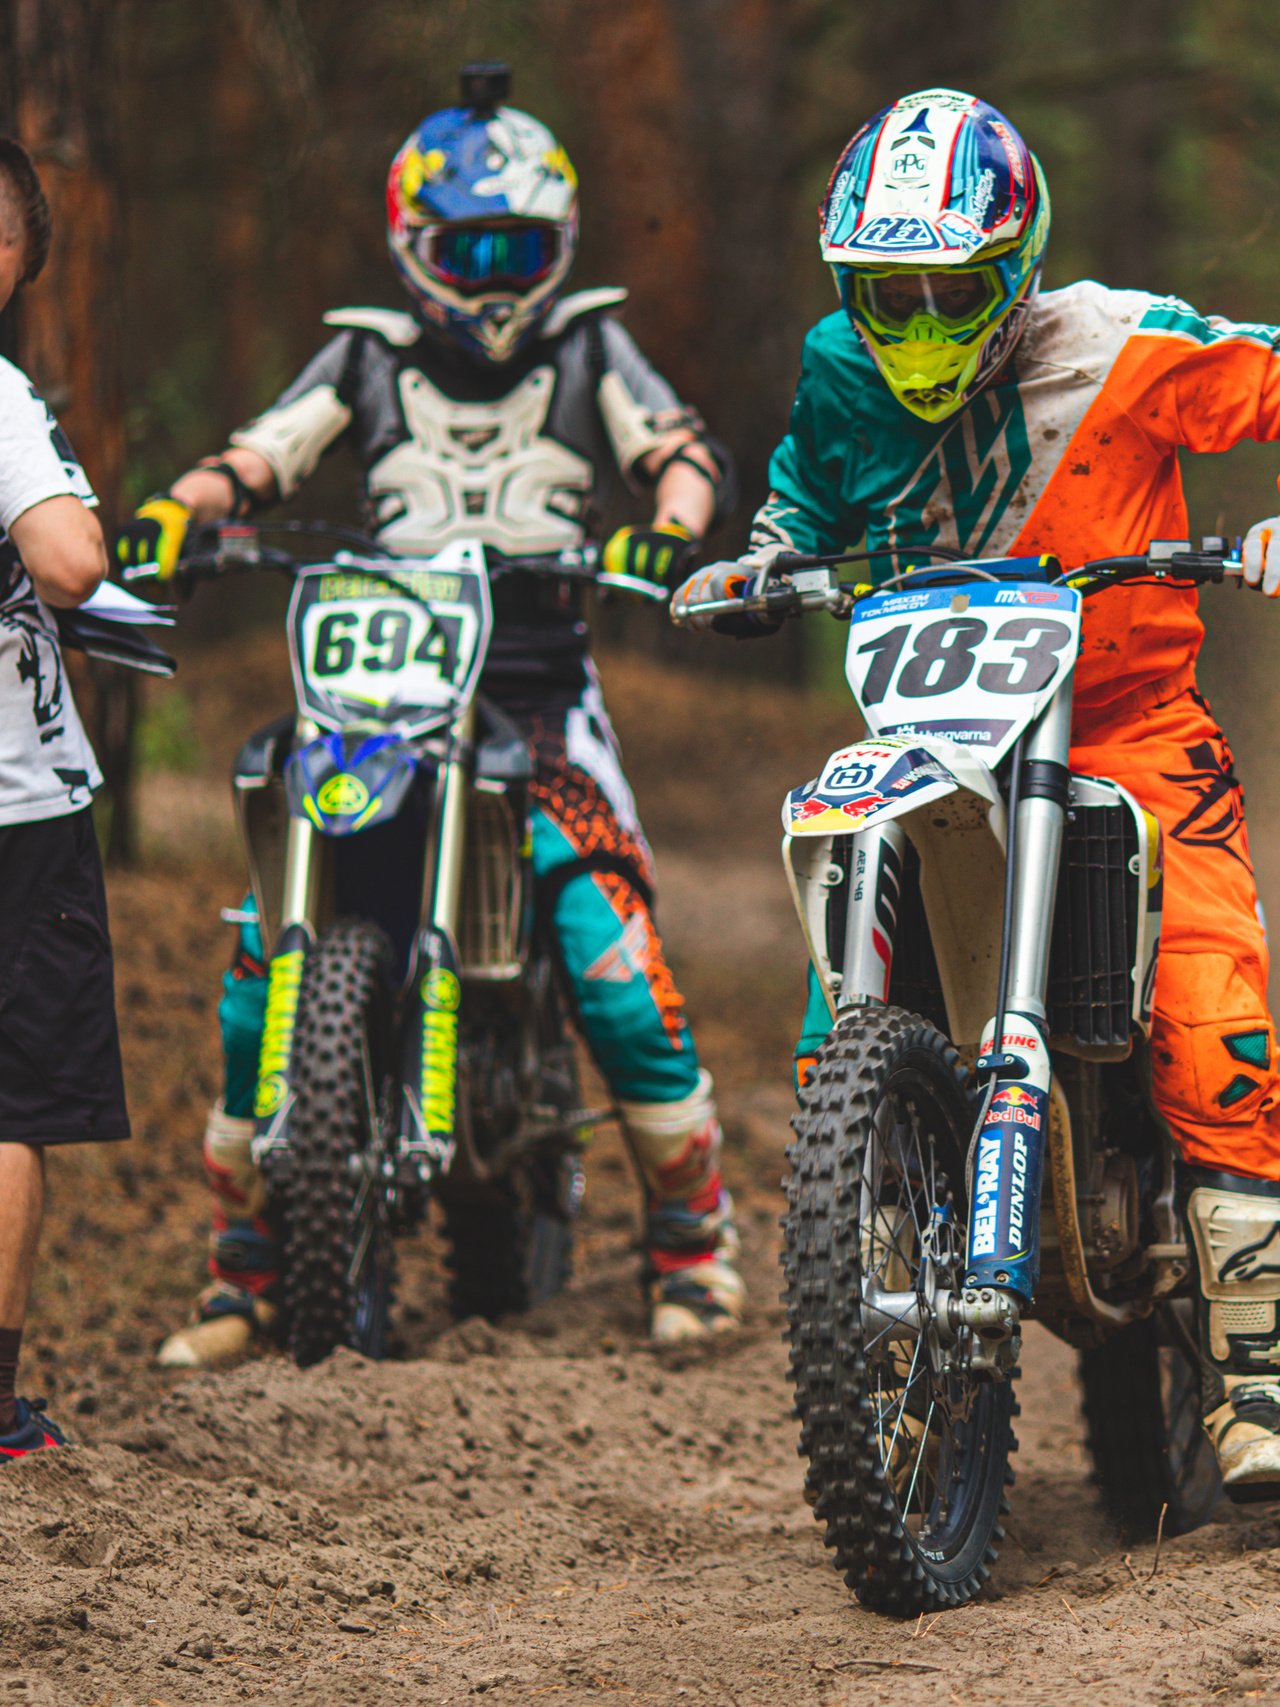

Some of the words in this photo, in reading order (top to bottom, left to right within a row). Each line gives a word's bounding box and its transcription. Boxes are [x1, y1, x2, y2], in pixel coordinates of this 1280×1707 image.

[860, 601, 929, 619] TOKMAKOV
[882, 593, 931, 608] MAXIM
[313, 610, 462, 677] 694
[856, 617, 1072, 708] 183
[856, 849, 867, 877] AER
[1014, 1106, 1041, 1132] Bull
[1008, 1132, 1028, 1251] DUNLOP
